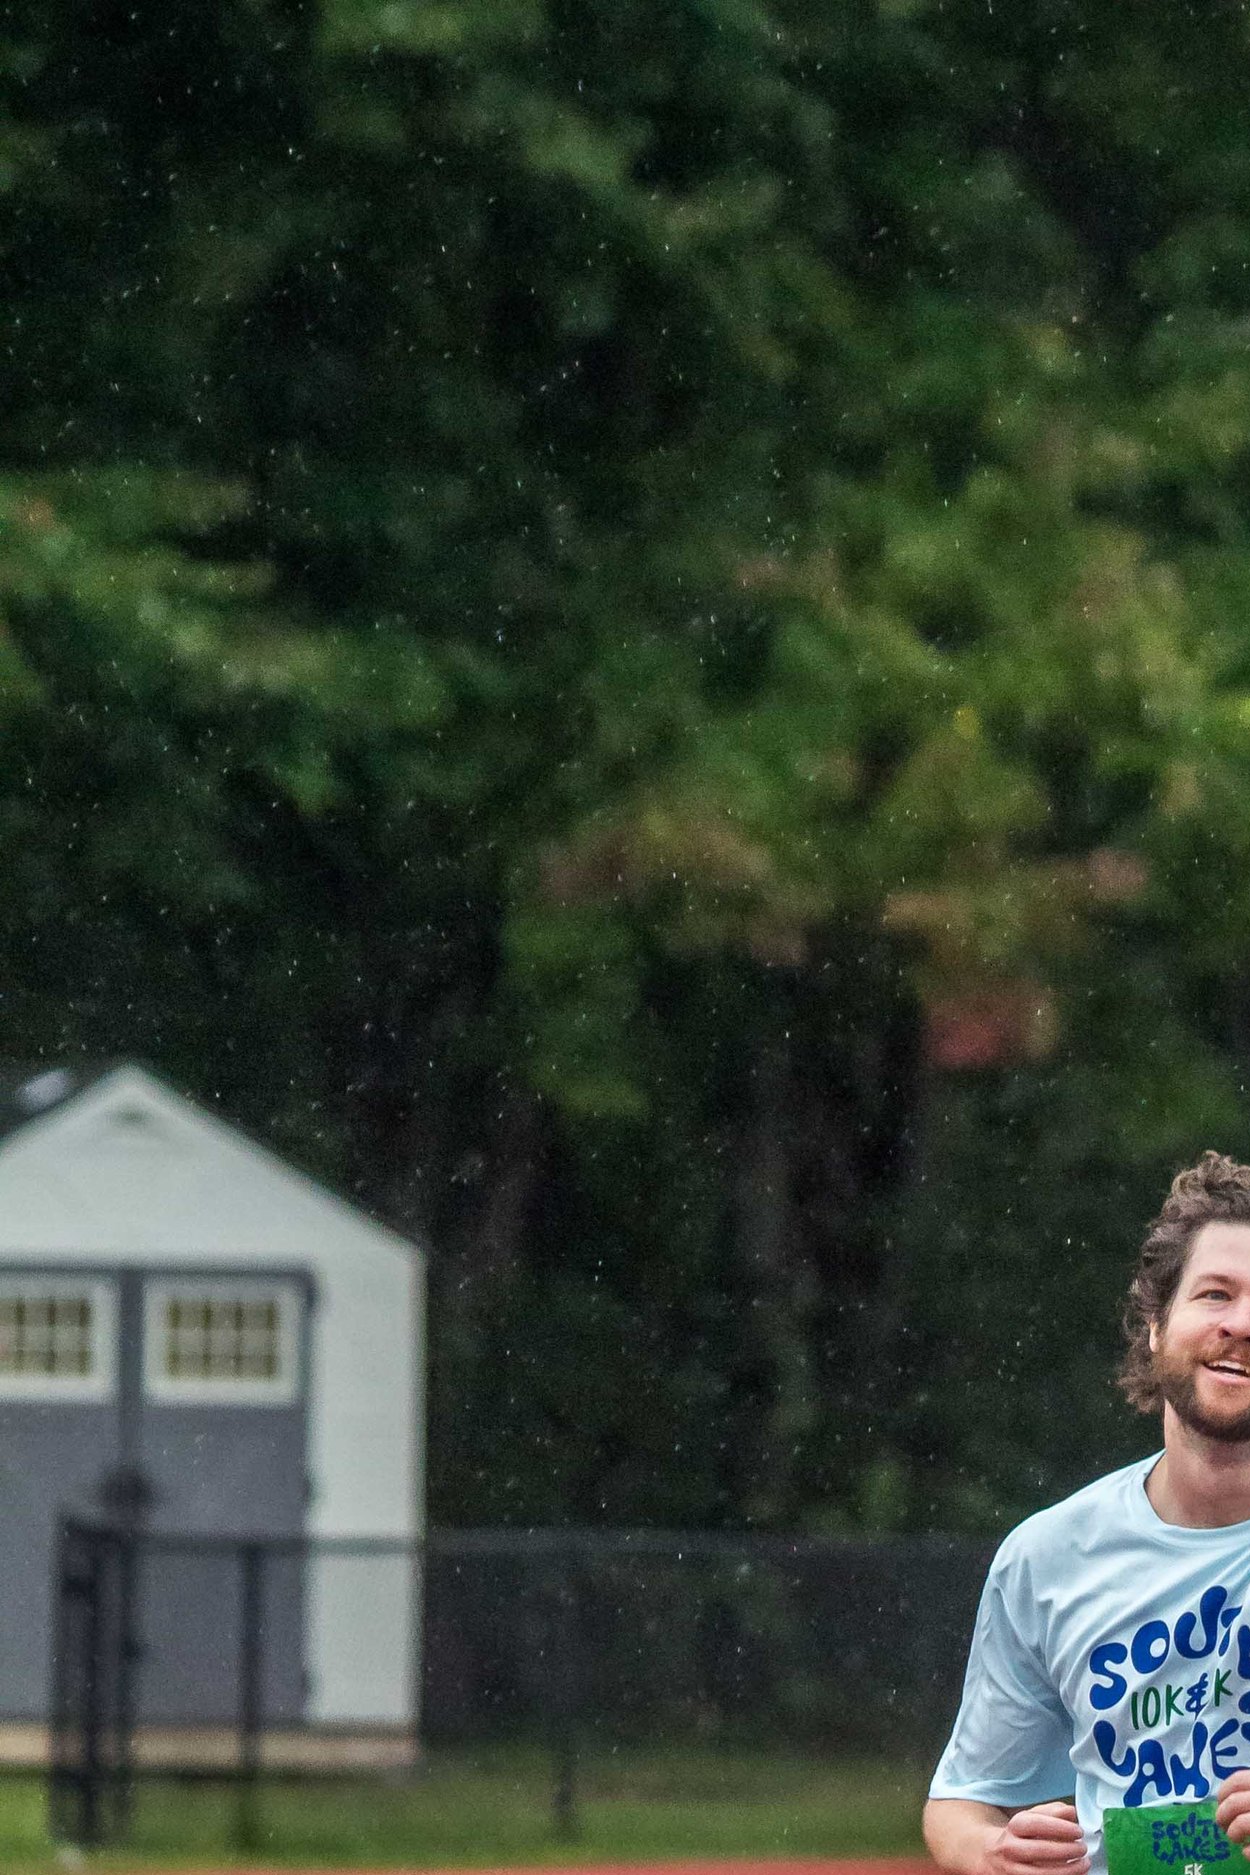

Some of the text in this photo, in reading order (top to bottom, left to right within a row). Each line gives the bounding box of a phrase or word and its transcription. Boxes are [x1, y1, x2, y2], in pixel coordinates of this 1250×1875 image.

[1130, 1684, 1185, 1730] 10K
[1213, 1667, 1234, 1708] K
[1152, 1836, 1231, 1866] LAKES
